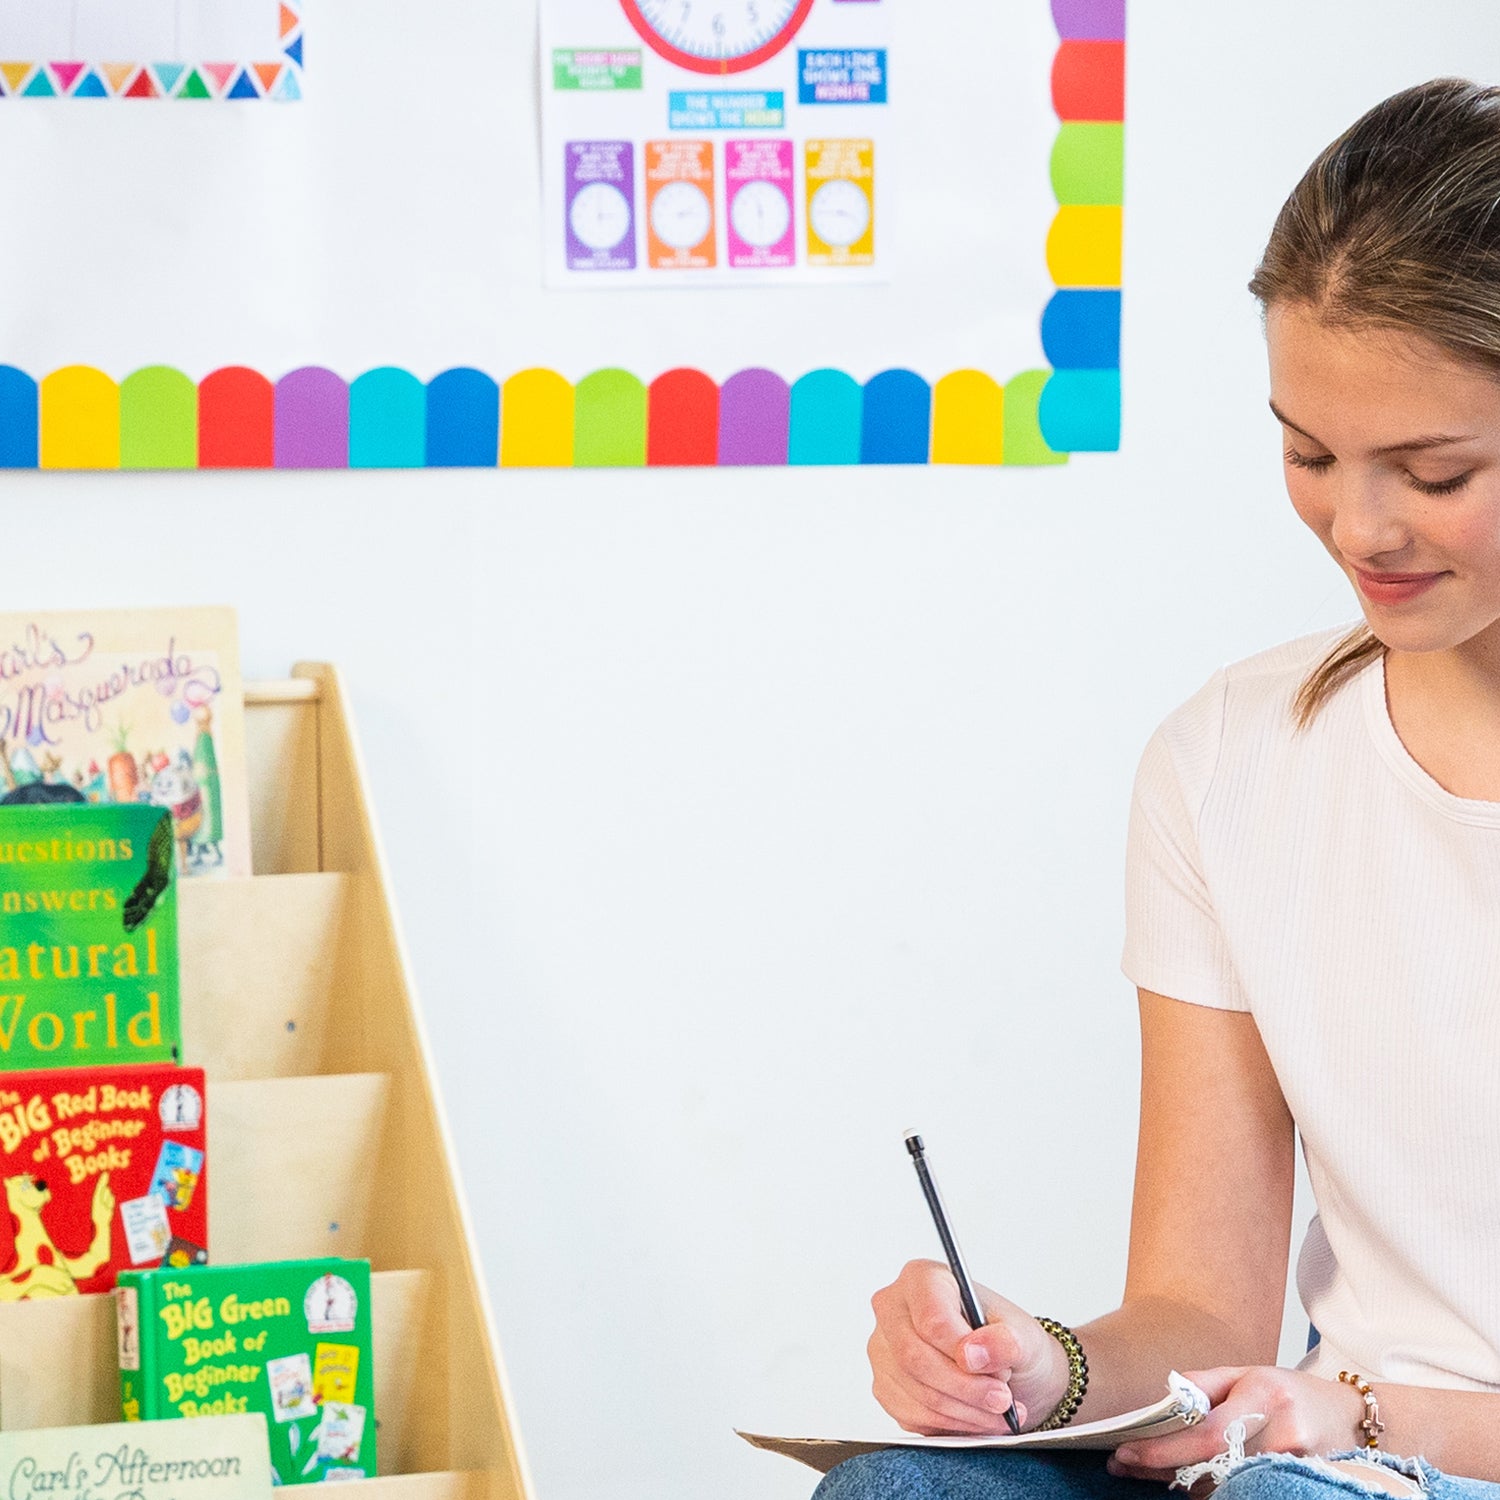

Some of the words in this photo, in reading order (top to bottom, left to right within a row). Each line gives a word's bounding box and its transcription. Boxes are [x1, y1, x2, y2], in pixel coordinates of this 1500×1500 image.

[712, 13, 726, 38] 6
[0, 623, 94, 679] arl's
[12, 637, 221, 745] Masquerade
[0, 830, 133, 864] uestions
[2, 888, 117, 913] nswers
[0, 928, 159, 981] atural
[0, 1094, 52, 1154] BIG
[51, 1085, 98, 1120] Red
[99, 1084, 152, 1112] Book
[32, 1137, 50, 1162] of
[51, 1119, 146, 1158] Beginner
[64, 1144, 132, 1185] Books
[162, 1281, 193, 1301] The
[159, 1296, 214, 1340] BIG
[219, 1293, 291, 1325] Green
[181, 1329, 237, 1366] Book
[242, 1330, 268, 1352] of
[163, 1364, 261, 1403] Beginner
[94, 1443, 242, 1487] Afternoon
